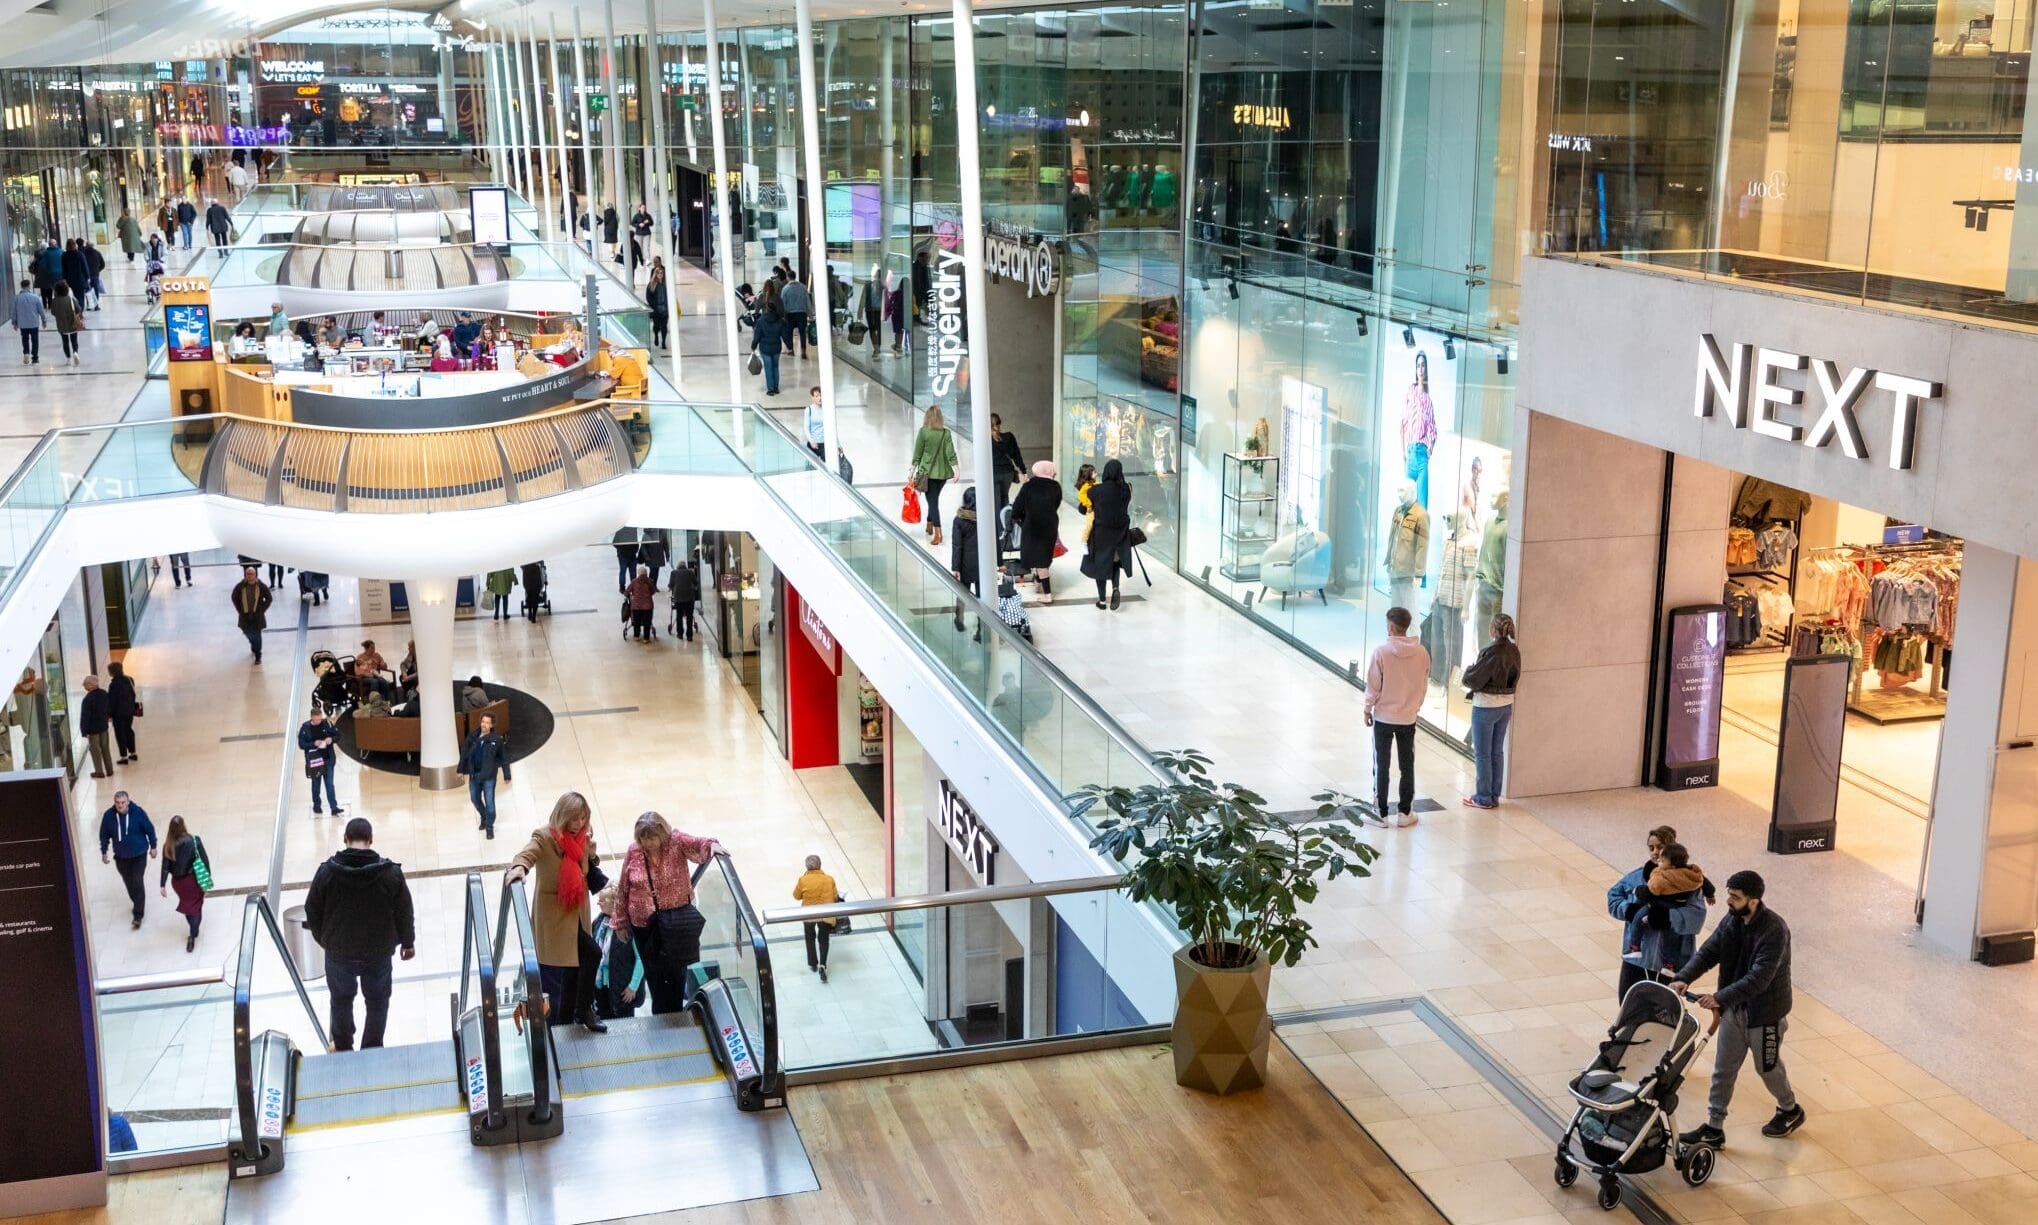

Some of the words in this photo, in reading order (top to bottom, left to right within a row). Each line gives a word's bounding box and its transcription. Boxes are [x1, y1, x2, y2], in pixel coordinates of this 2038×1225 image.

[261, 60, 325, 73] WELCOME
[274, 73, 296, 82] LET'S
[296, 73, 312, 82] EAT
[339, 83, 382, 93] TORTILLA
[162, 280, 207, 292] COSTA
[531, 382, 553, 396] HEART
[1694, 333, 1943, 471] NEXT
[1685, 774, 1710, 786] next
[939, 779, 999, 888] NEXT
[1798, 838, 1825, 849] next
[25, 861, 40, 869] parks
[5, 920, 36, 928] restaurants
[16, 927, 27, 936] golf
